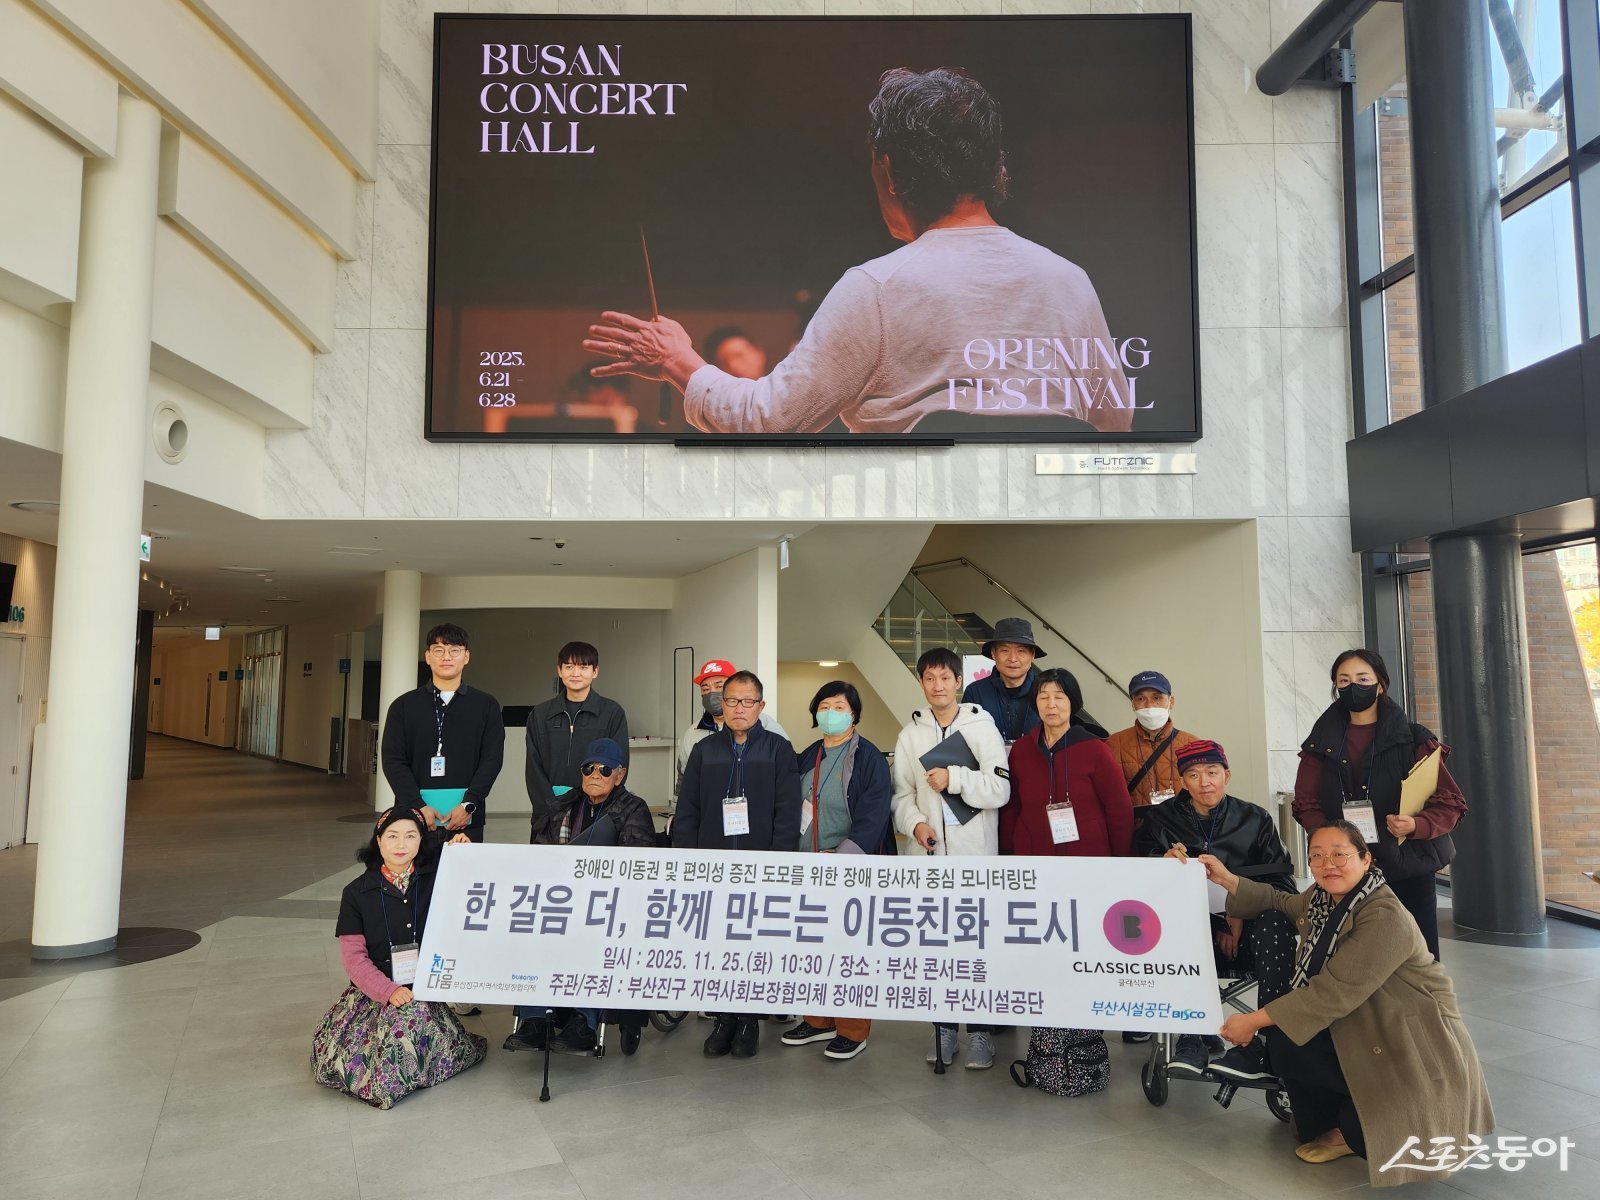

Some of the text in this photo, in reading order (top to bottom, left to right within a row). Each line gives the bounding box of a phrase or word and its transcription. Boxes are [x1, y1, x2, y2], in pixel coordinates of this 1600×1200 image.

[481, 43, 622, 76] BUSAN
[480, 82, 688, 115] CONCERT
[479, 121, 595, 154] HALL
[479, 351, 526, 366] 2025.
[963, 336, 1152, 370] OPENING
[479, 372, 511, 388] 6.21
[947, 376, 1155, 410] FESTIVAL
[479, 392, 516, 408] 6.28
[573, 858, 1038, 891] 장애인 이동권 및 편의성 증진 도모를 위한 장애 당사자 중심 모니터링단
[463, 882, 1080, 953] 한 걸음 더, 함께 만드는 이동친화 도시
[1122, 915, 1143, 939] B
[603, 946, 633, 970] 일시
[645, 948, 688, 971] 2025.
[694, 950, 715, 971] 11.
[721, 950, 773, 976] 25.(화)
[780, 953, 823, 975] 10:30
[839, 954, 870, 979] 장소
[886, 956, 918, 981] 부산
[923, 957, 988, 982] 콘서트홀
[1073, 961, 1201, 977] CLASSIC BUSAN
[548, 973, 614, 998] 주관/주최
[627, 976, 687, 1001] 부산진구
[690, 978, 828, 1007] 지역사회보장협의체
[832, 983, 879, 1008] 장애인
[885, 985, 937, 1012] 위원회,
[943, 988, 1045, 1015] 부산시설공단
[1091, 1001, 1206, 1021] 부산시설공단 BISCO
